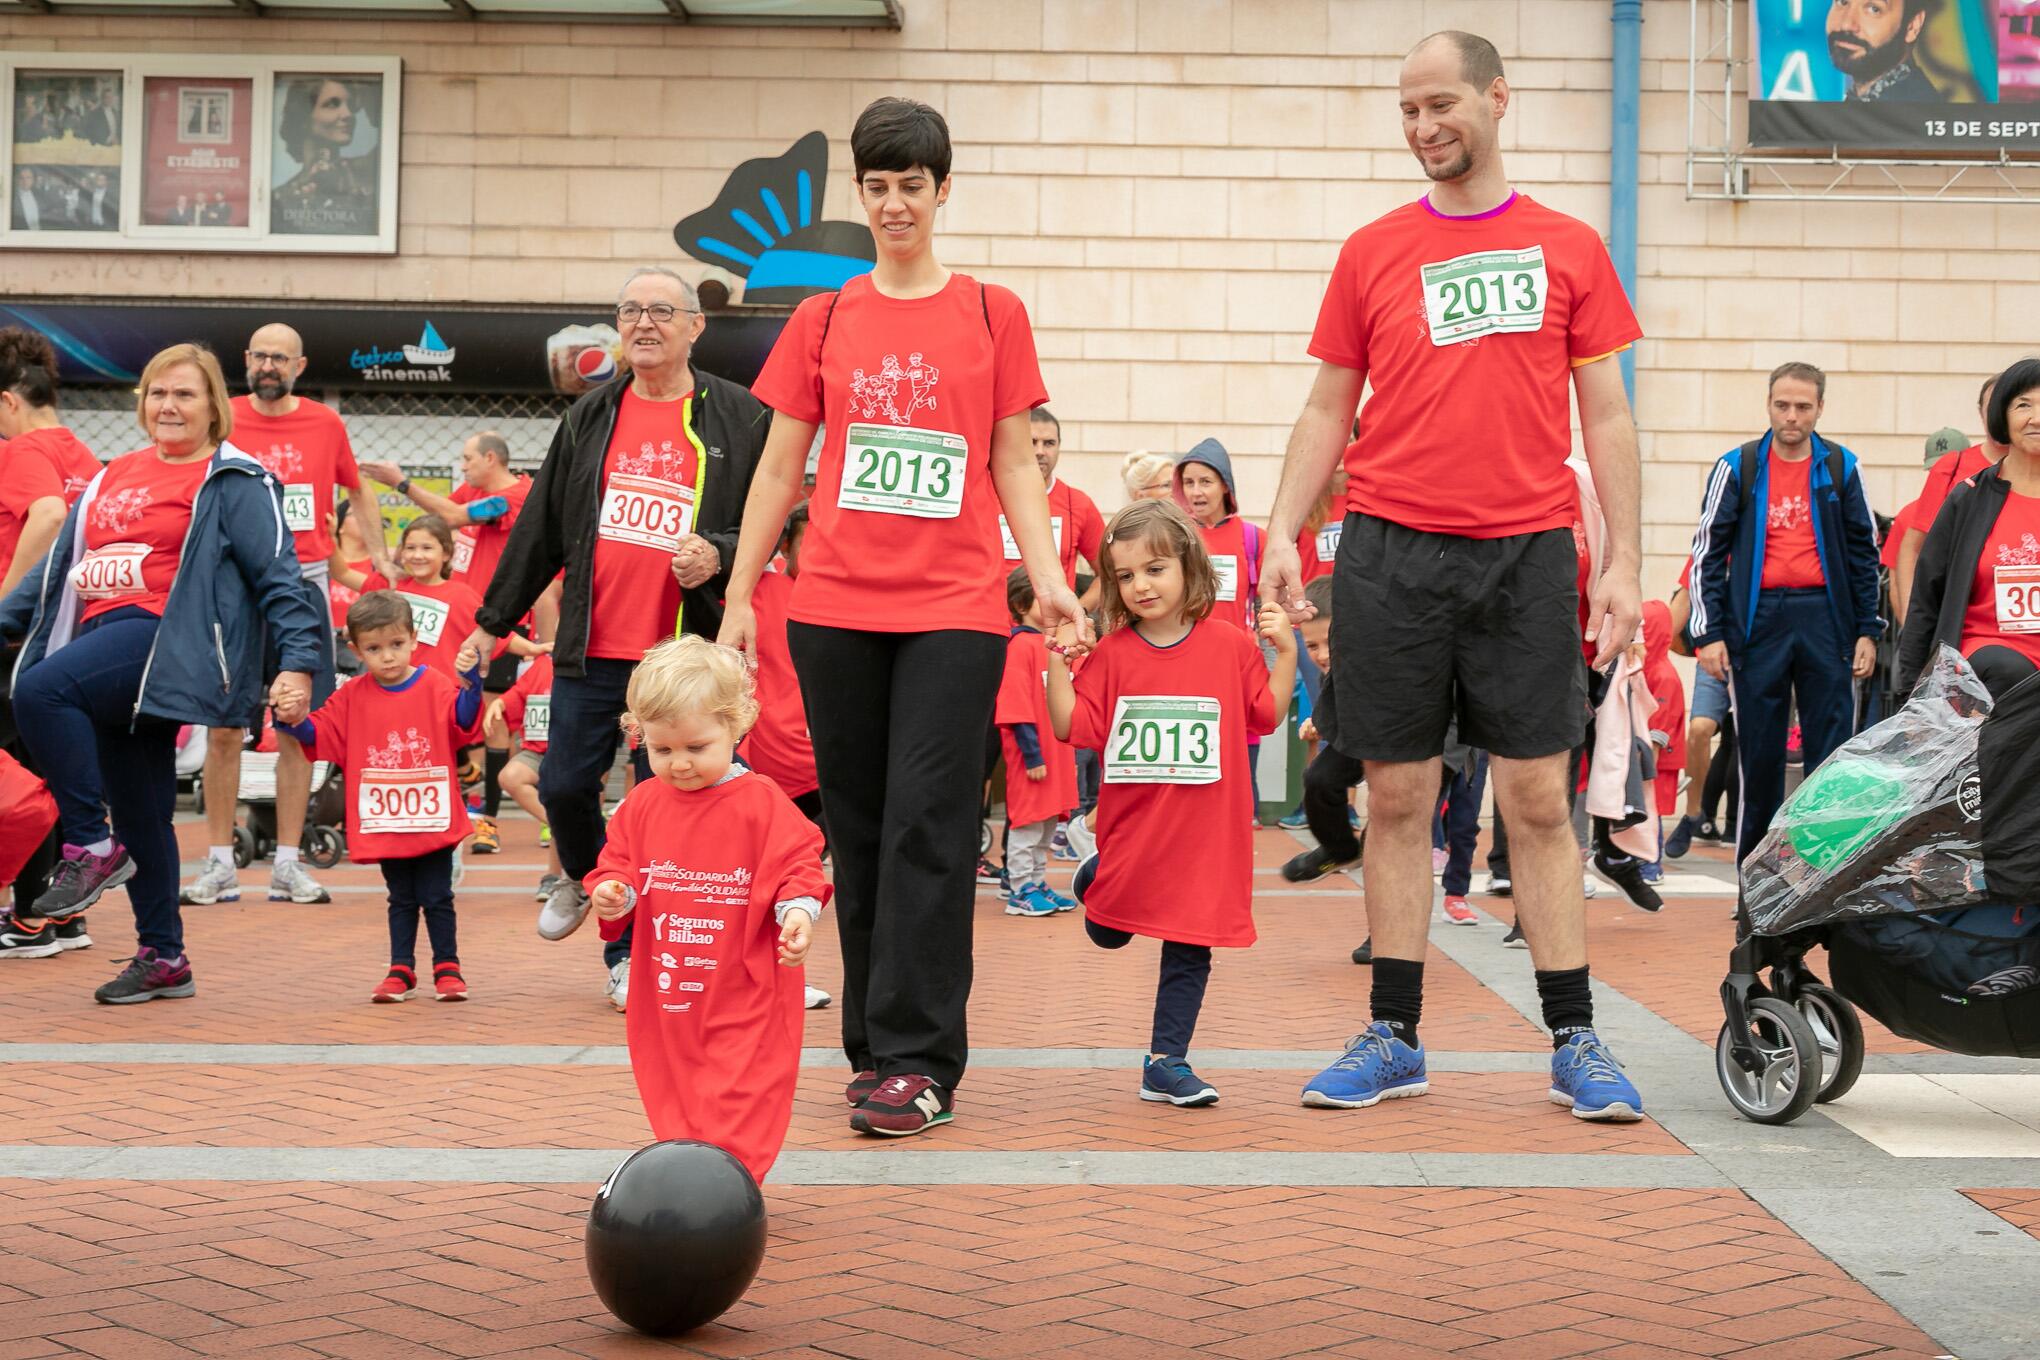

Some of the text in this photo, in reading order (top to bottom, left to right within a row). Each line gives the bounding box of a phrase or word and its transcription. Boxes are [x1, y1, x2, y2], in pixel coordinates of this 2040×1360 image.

[1925, 121, 2040, 137] 13 DE SEPT
[1439, 273, 1538, 322] 2013
[350, 344, 404, 369] Getxo
[362, 364, 452, 381] zinemak
[854, 448, 952, 498] 2013
[610, 494, 683, 536] 3003
[76, 559, 134, 589] 3003
[2007, 586, 2040, 618] 30
[1118, 721, 1209, 764] 2013
[369, 785, 440, 816] 3003
[667, 929, 714, 945] Bilbao
[668, 913, 725, 931] Seguros
[913, 1087, 942, 1122] N
